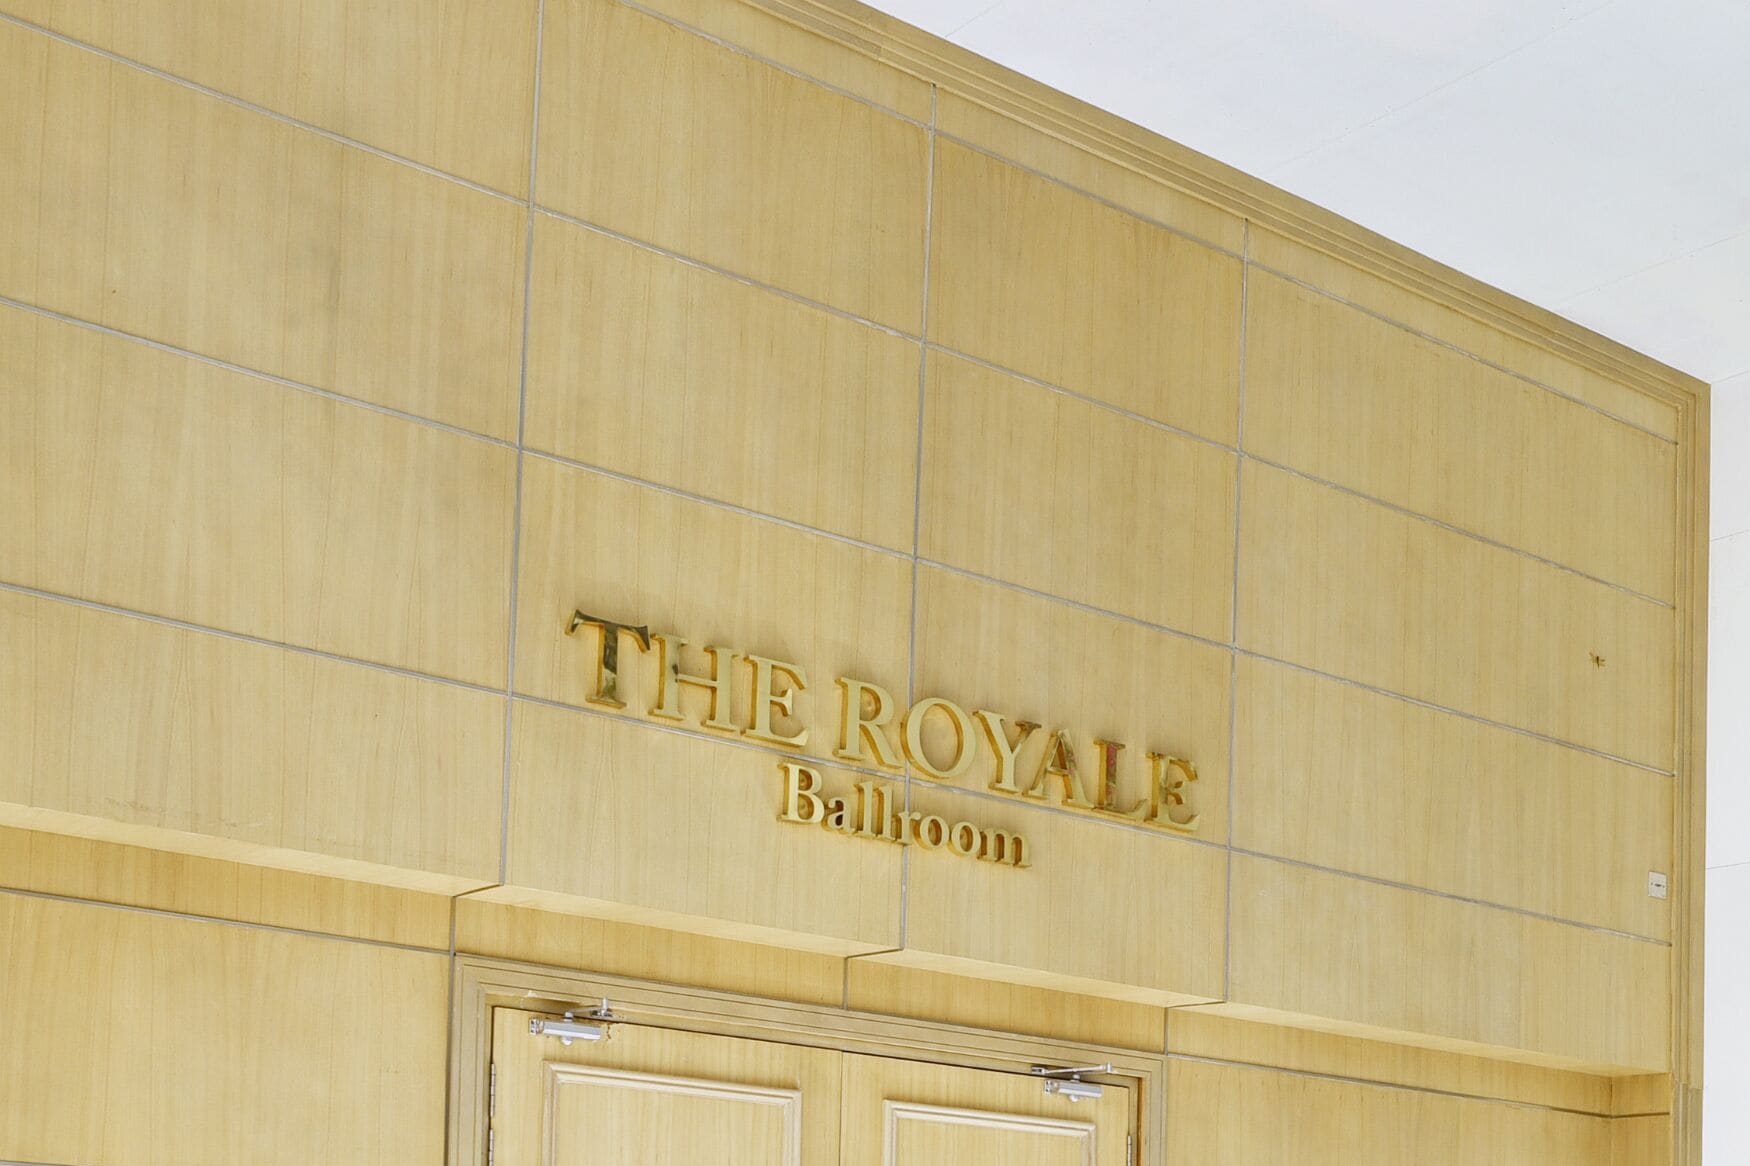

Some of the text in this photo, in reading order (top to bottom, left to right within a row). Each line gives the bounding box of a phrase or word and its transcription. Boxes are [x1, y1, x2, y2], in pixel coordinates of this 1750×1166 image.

[565, 609, 1199, 832] THE ROYALE
[777, 760, 1032, 868] Ballroom
